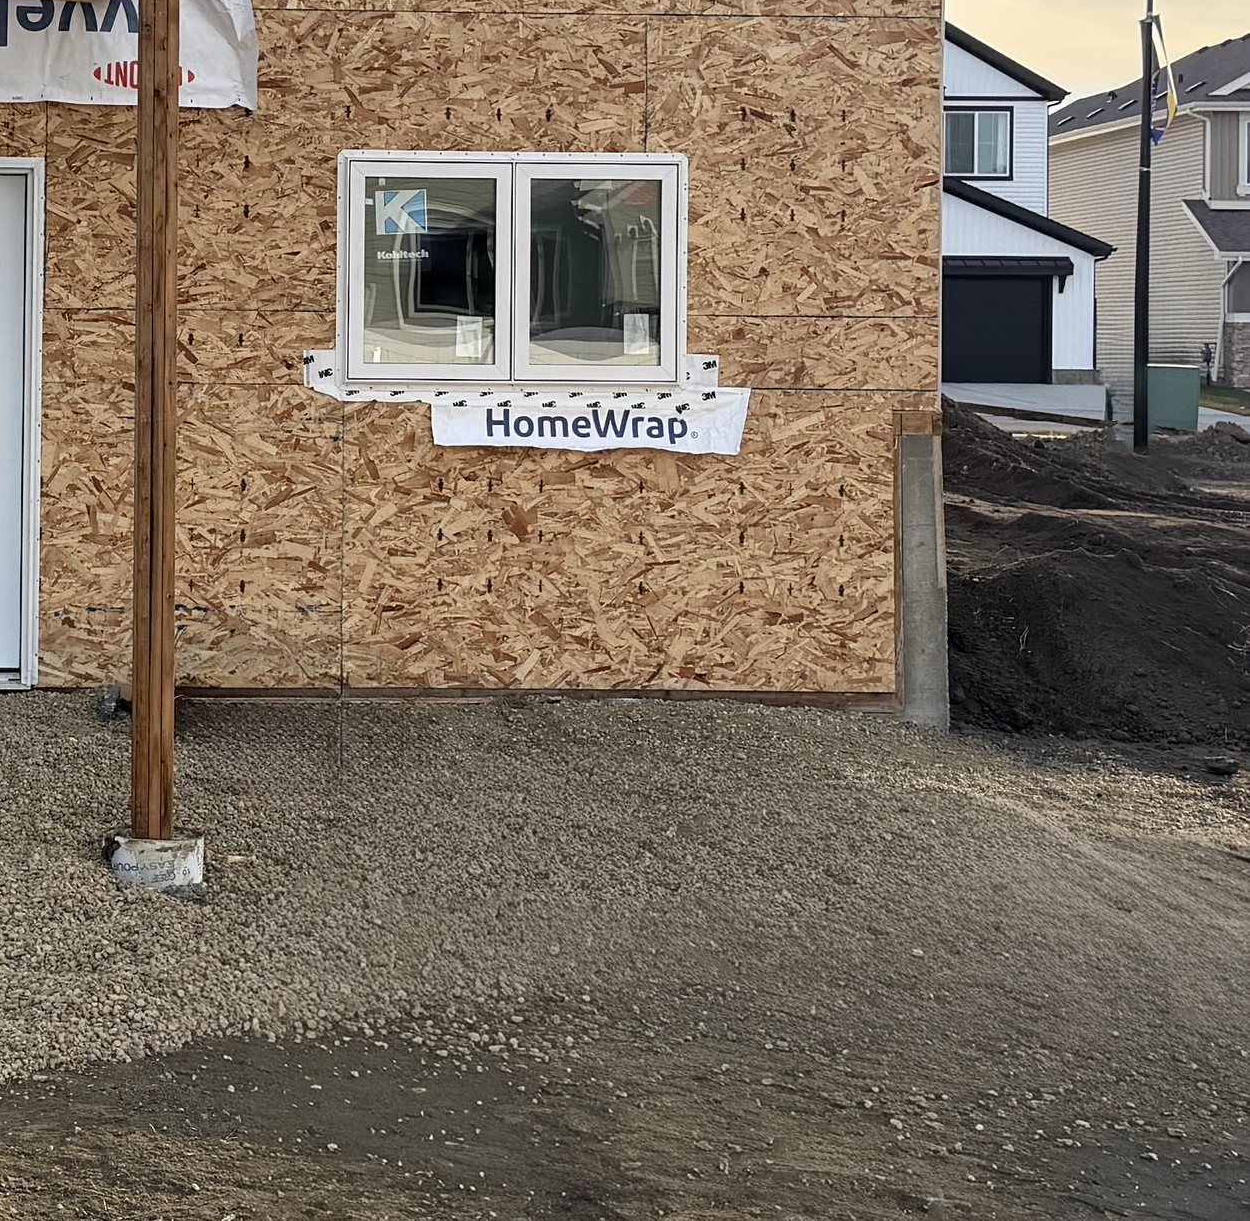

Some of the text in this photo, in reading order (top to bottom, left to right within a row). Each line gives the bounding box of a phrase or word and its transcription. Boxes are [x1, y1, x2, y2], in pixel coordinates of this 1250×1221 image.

[377, 249, 429, 259] Kohltech
[702, 360, 717, 370] 3M
[318, 368, 333, 379] 3M
[701, 391, 716, 400] 3M
